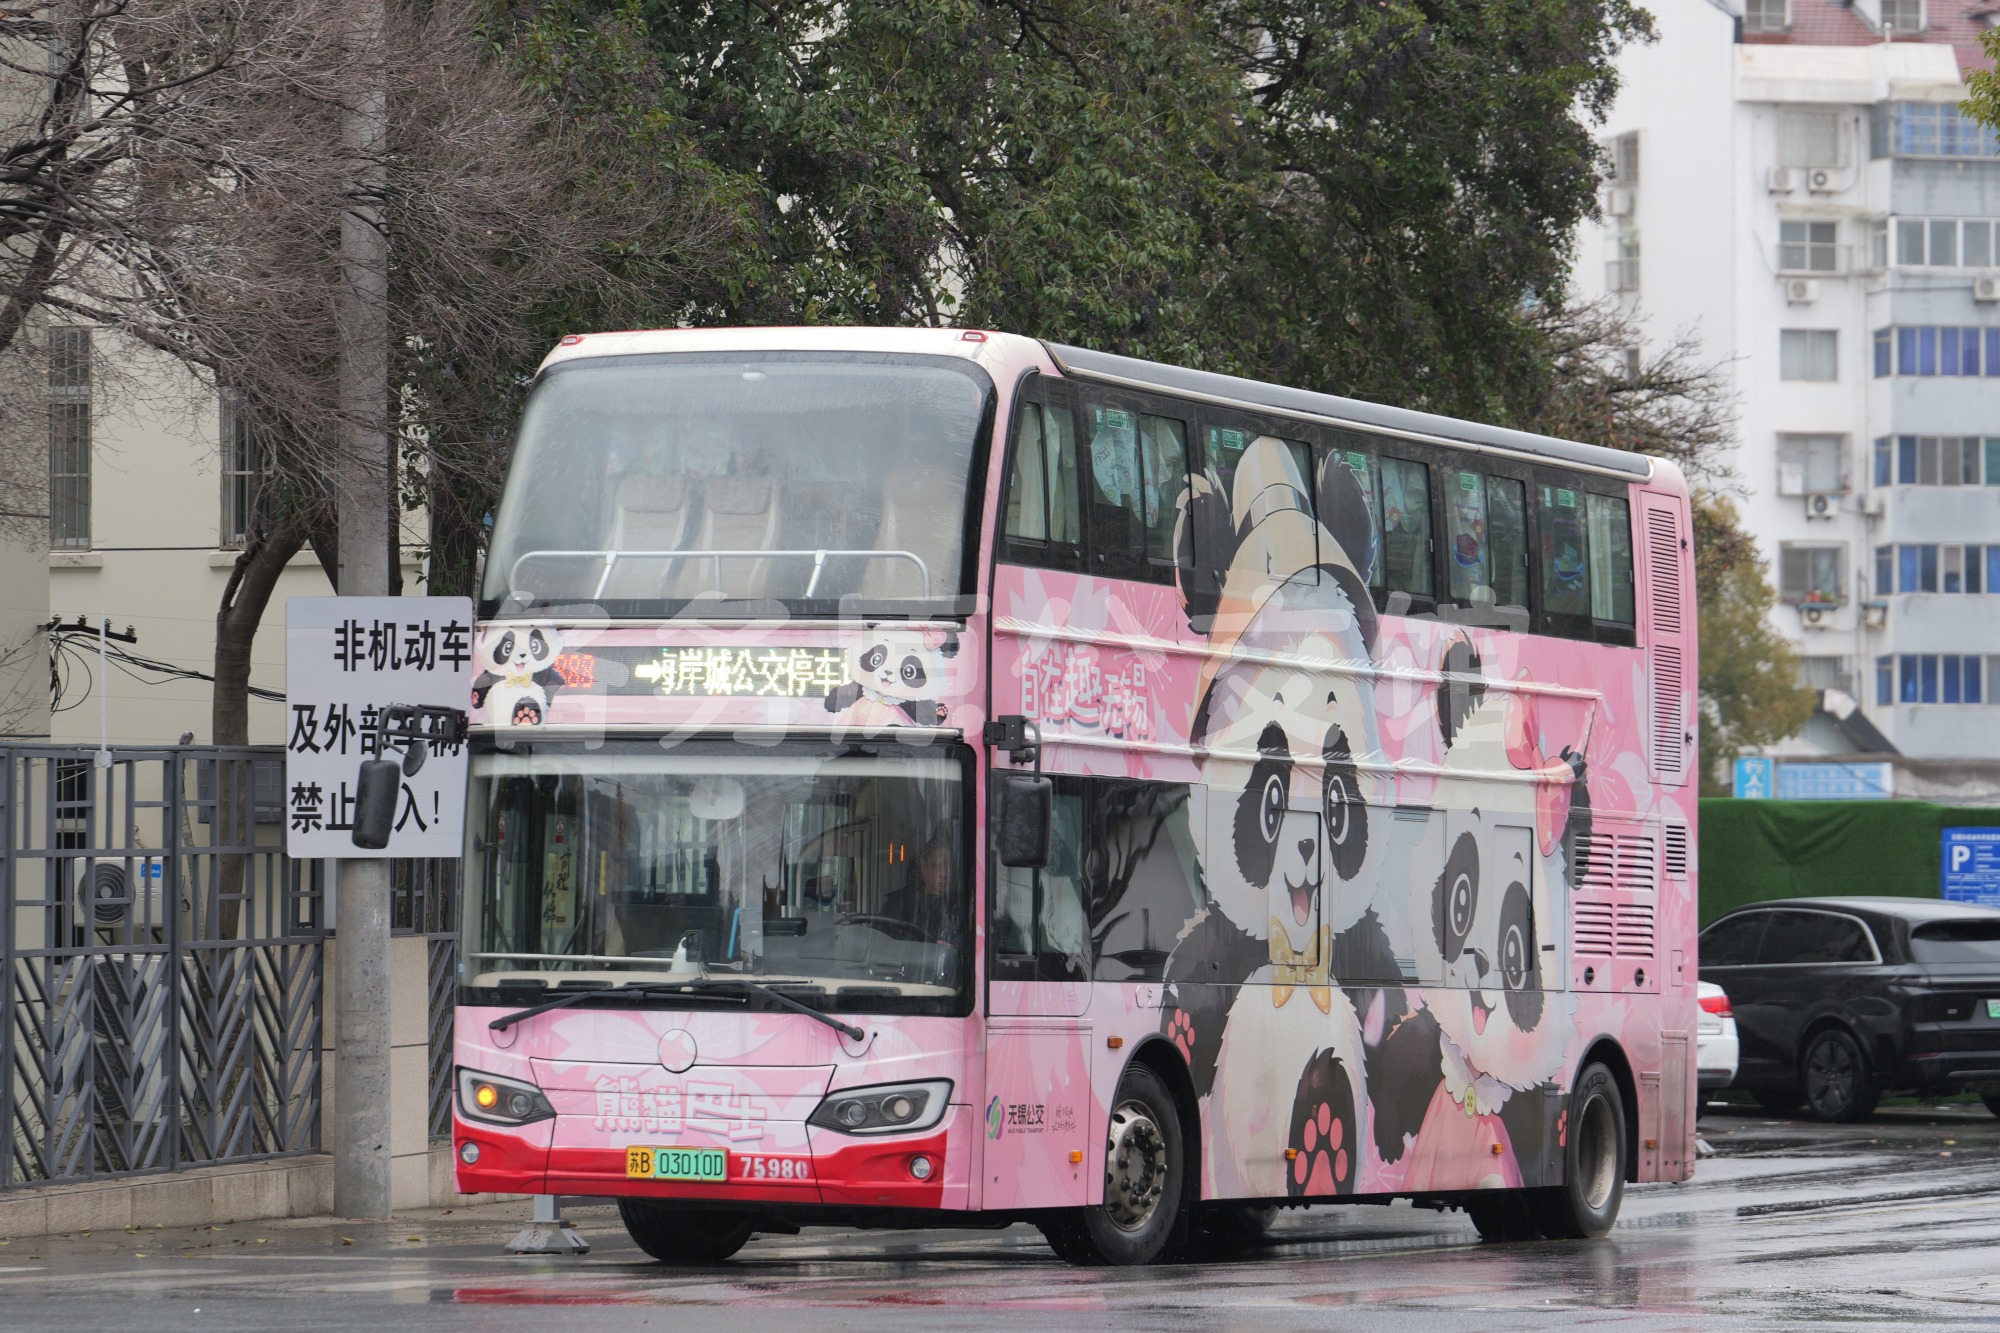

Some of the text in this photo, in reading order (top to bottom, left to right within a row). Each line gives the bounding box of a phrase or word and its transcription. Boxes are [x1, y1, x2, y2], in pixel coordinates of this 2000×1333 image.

[334, 619, 471, 672] 非机动车
[1020, 645, 1150, 732] 自在趣无锡
[291, 781, 439, 834] 禁止入!
[1952, 845, 1971, 872] P
[594, 1075, 766, 1141] 熊猫巴士
[1008, 1104, 1045, 1125] 无锡公交
[630, 1152, 724, 1176] 苏B 03010D
[740, 1156, 809, 1179] 75980
